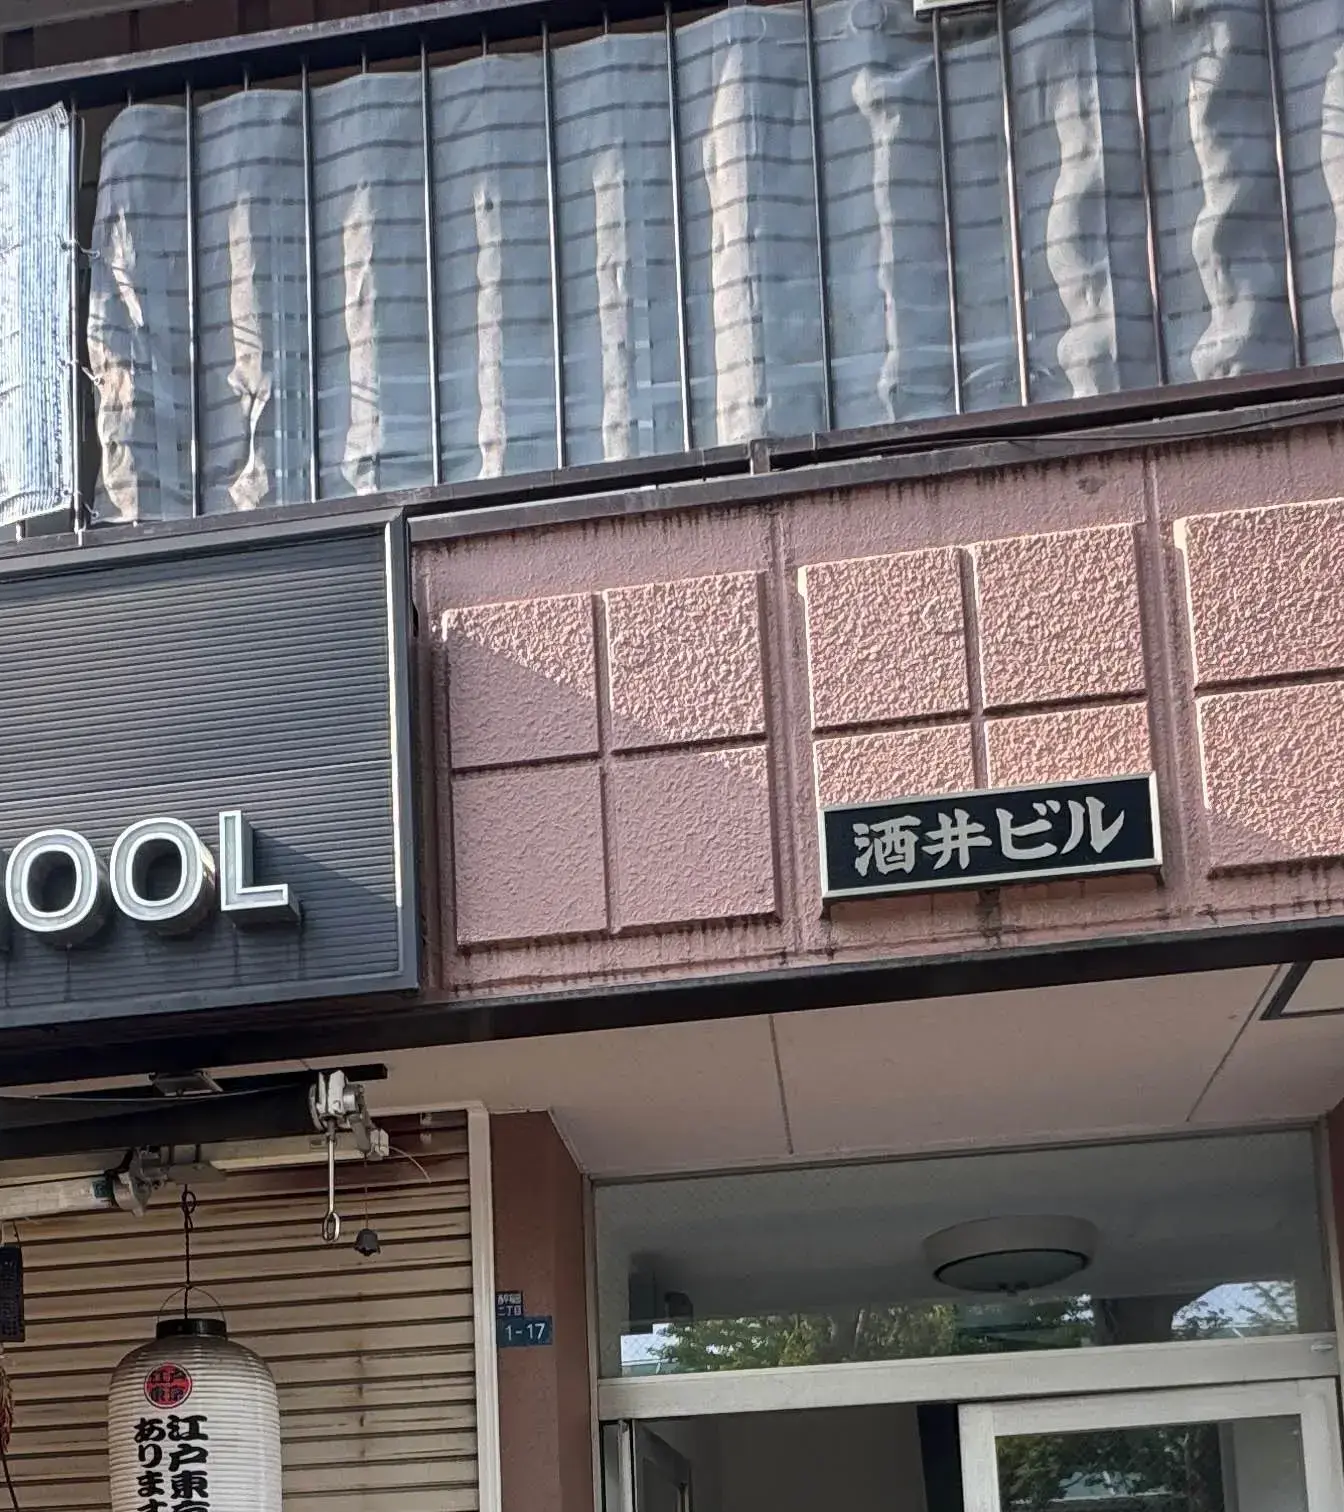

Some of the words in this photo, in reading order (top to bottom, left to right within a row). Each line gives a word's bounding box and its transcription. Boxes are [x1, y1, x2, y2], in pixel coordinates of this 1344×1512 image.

[852, 795, 1125, 877] 酒井ビル
[505, 1322, 546, 1341] 1-17
